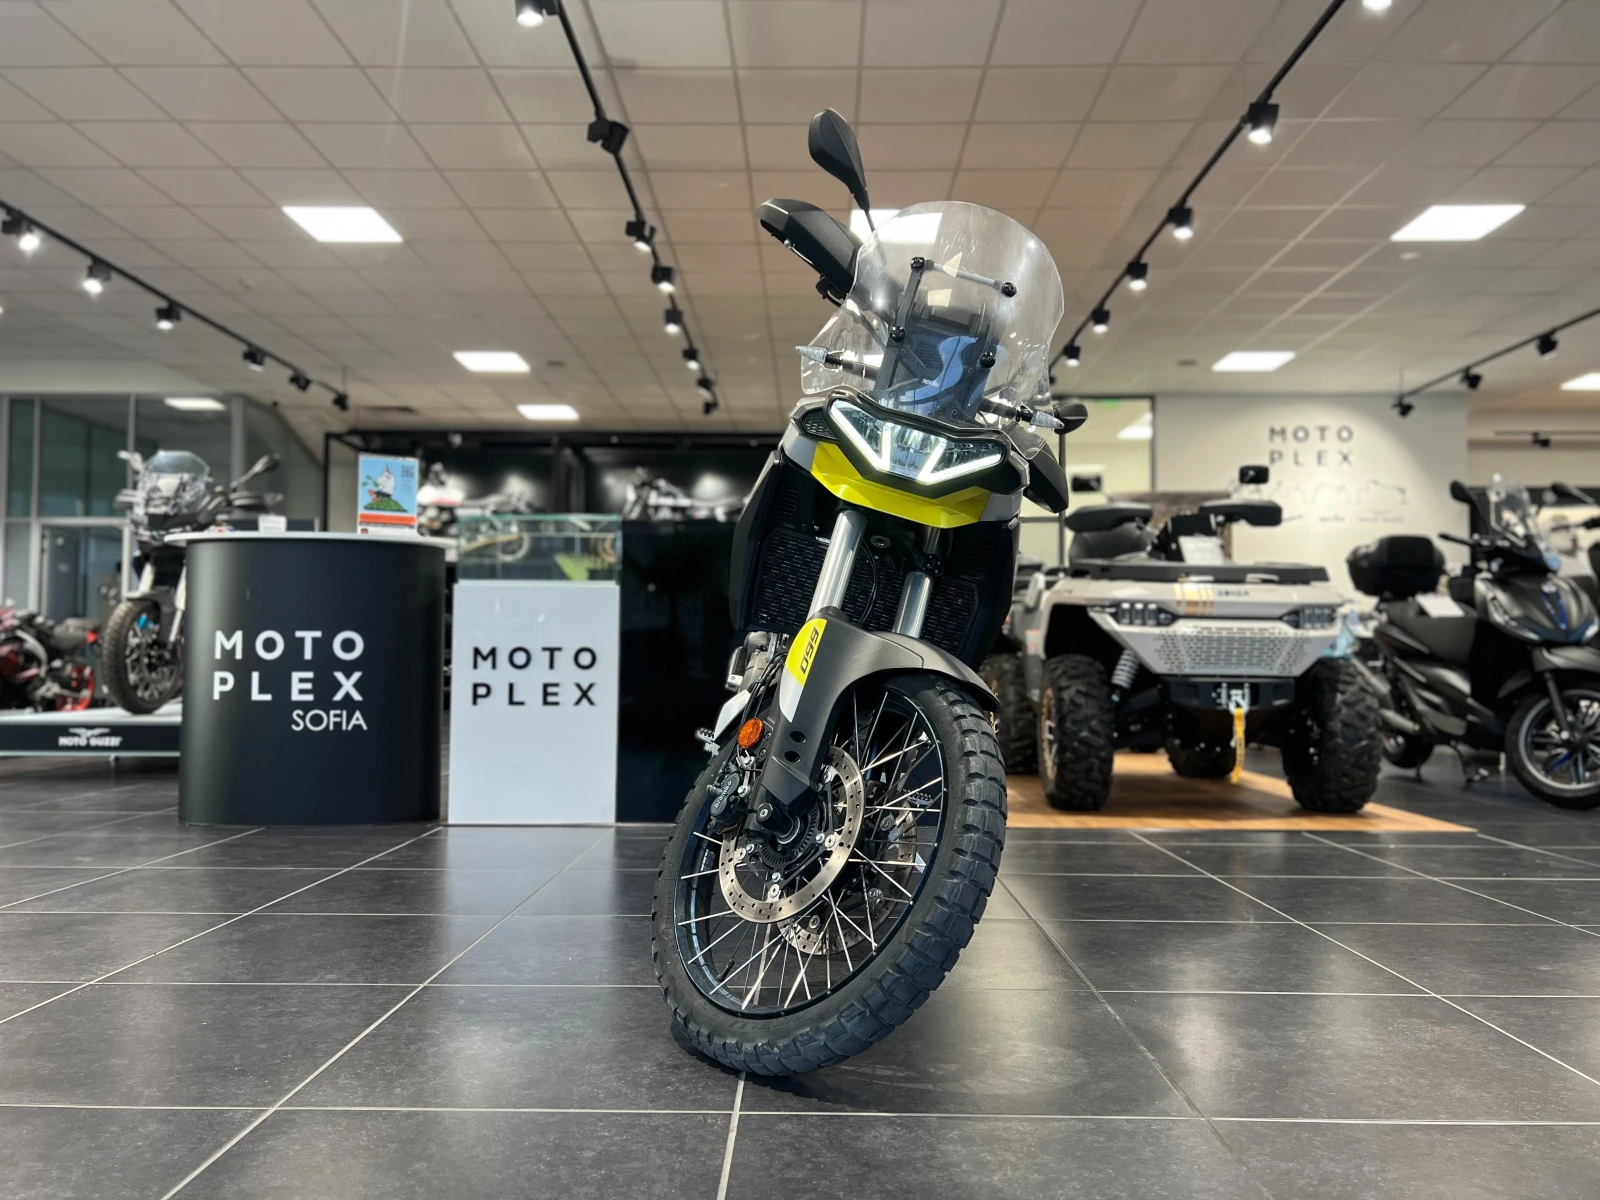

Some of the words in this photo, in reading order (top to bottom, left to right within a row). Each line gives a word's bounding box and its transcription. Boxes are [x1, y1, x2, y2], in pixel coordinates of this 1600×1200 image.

[1268, 425, 1354, 443] MOTO
[1268, 449, 1353, 467] PLEX
[214, 630, 365, 661] MOTO
[800, 626, 820, 675] 660
[472, 646, 597, 670] MOTO
[213, 671, 364, 701] PLEX
[472, 682, 597, 706] PLEX
[291, 709, 368, 731] SOFIA
[58, 736, 88, 747] MOTO
[713, 780, 732, 808] brembo
